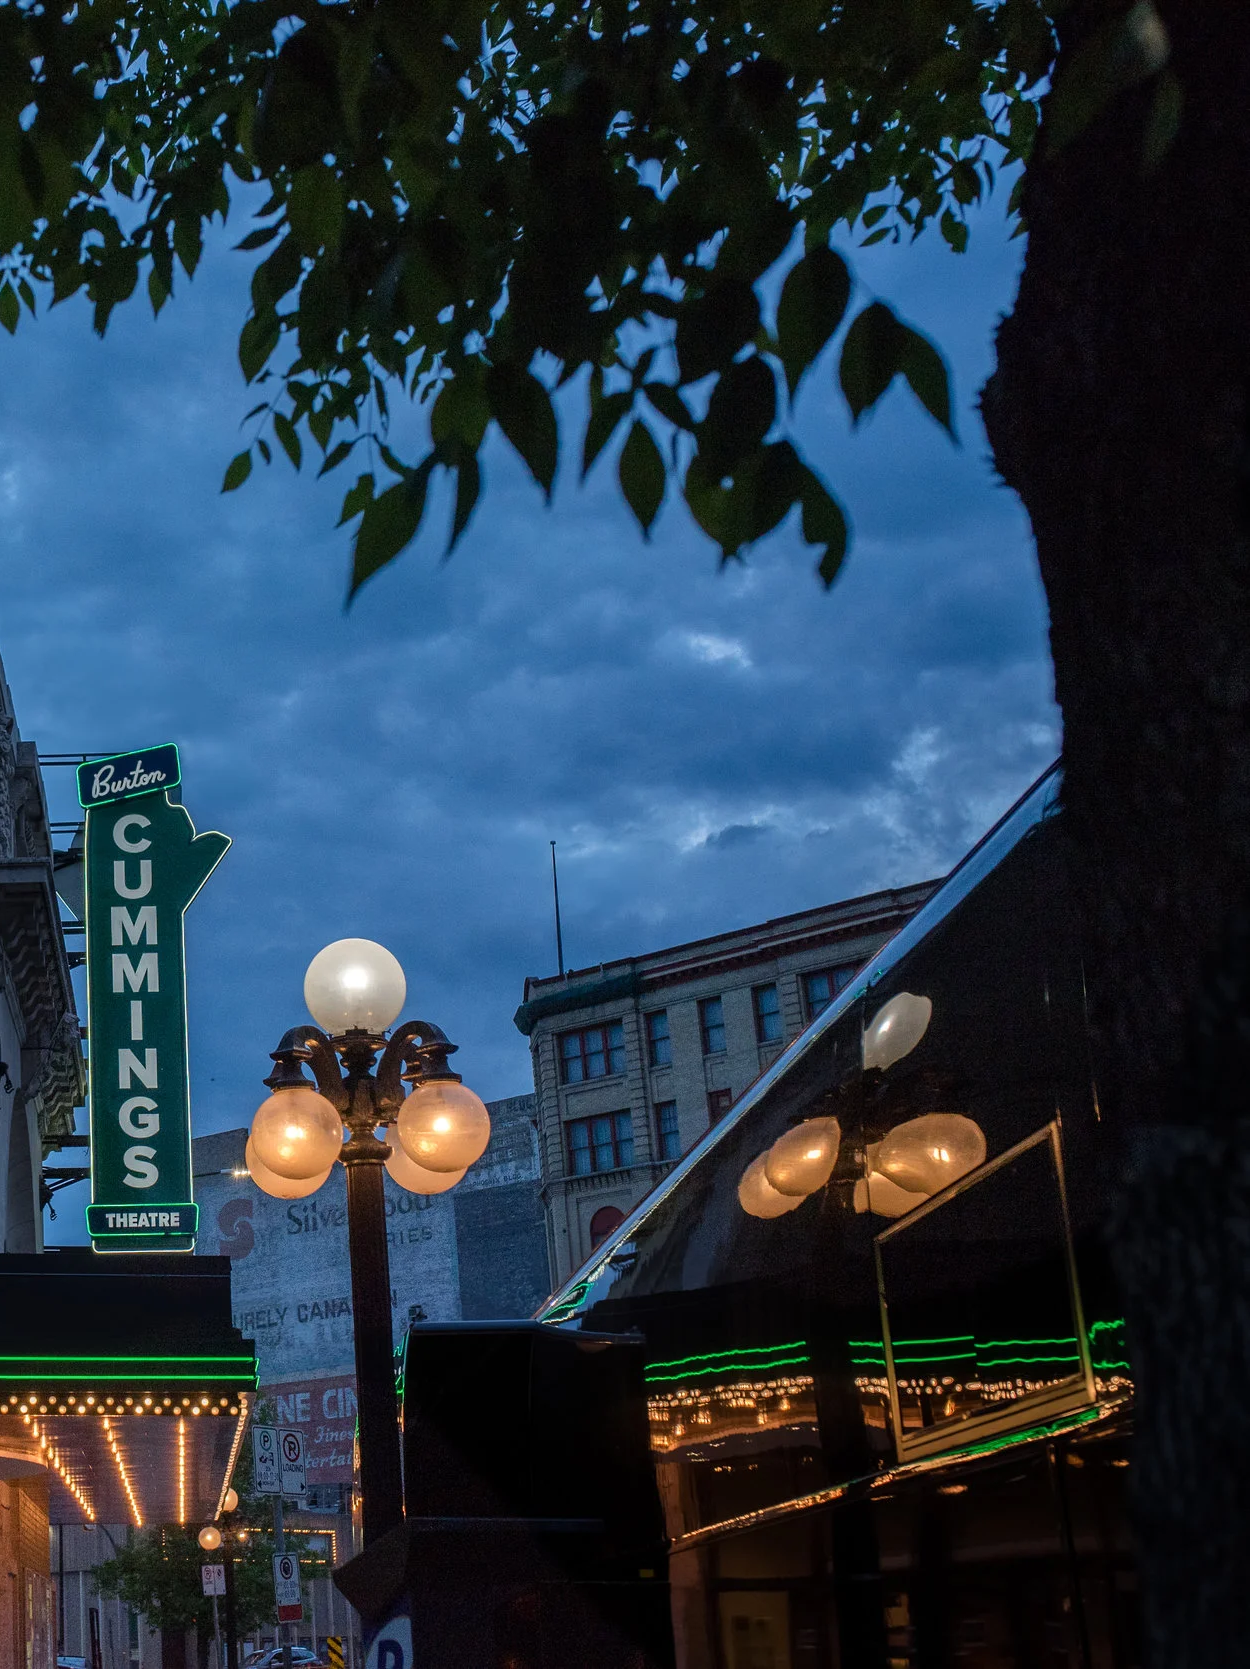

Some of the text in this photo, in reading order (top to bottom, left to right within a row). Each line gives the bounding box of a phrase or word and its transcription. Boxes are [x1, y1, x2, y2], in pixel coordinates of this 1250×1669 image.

[91, 764, 166, 799] Burton
[111, 813, 160, 1189] CUMMINGS
[105, 1212, 180, 1229] THEATRE
